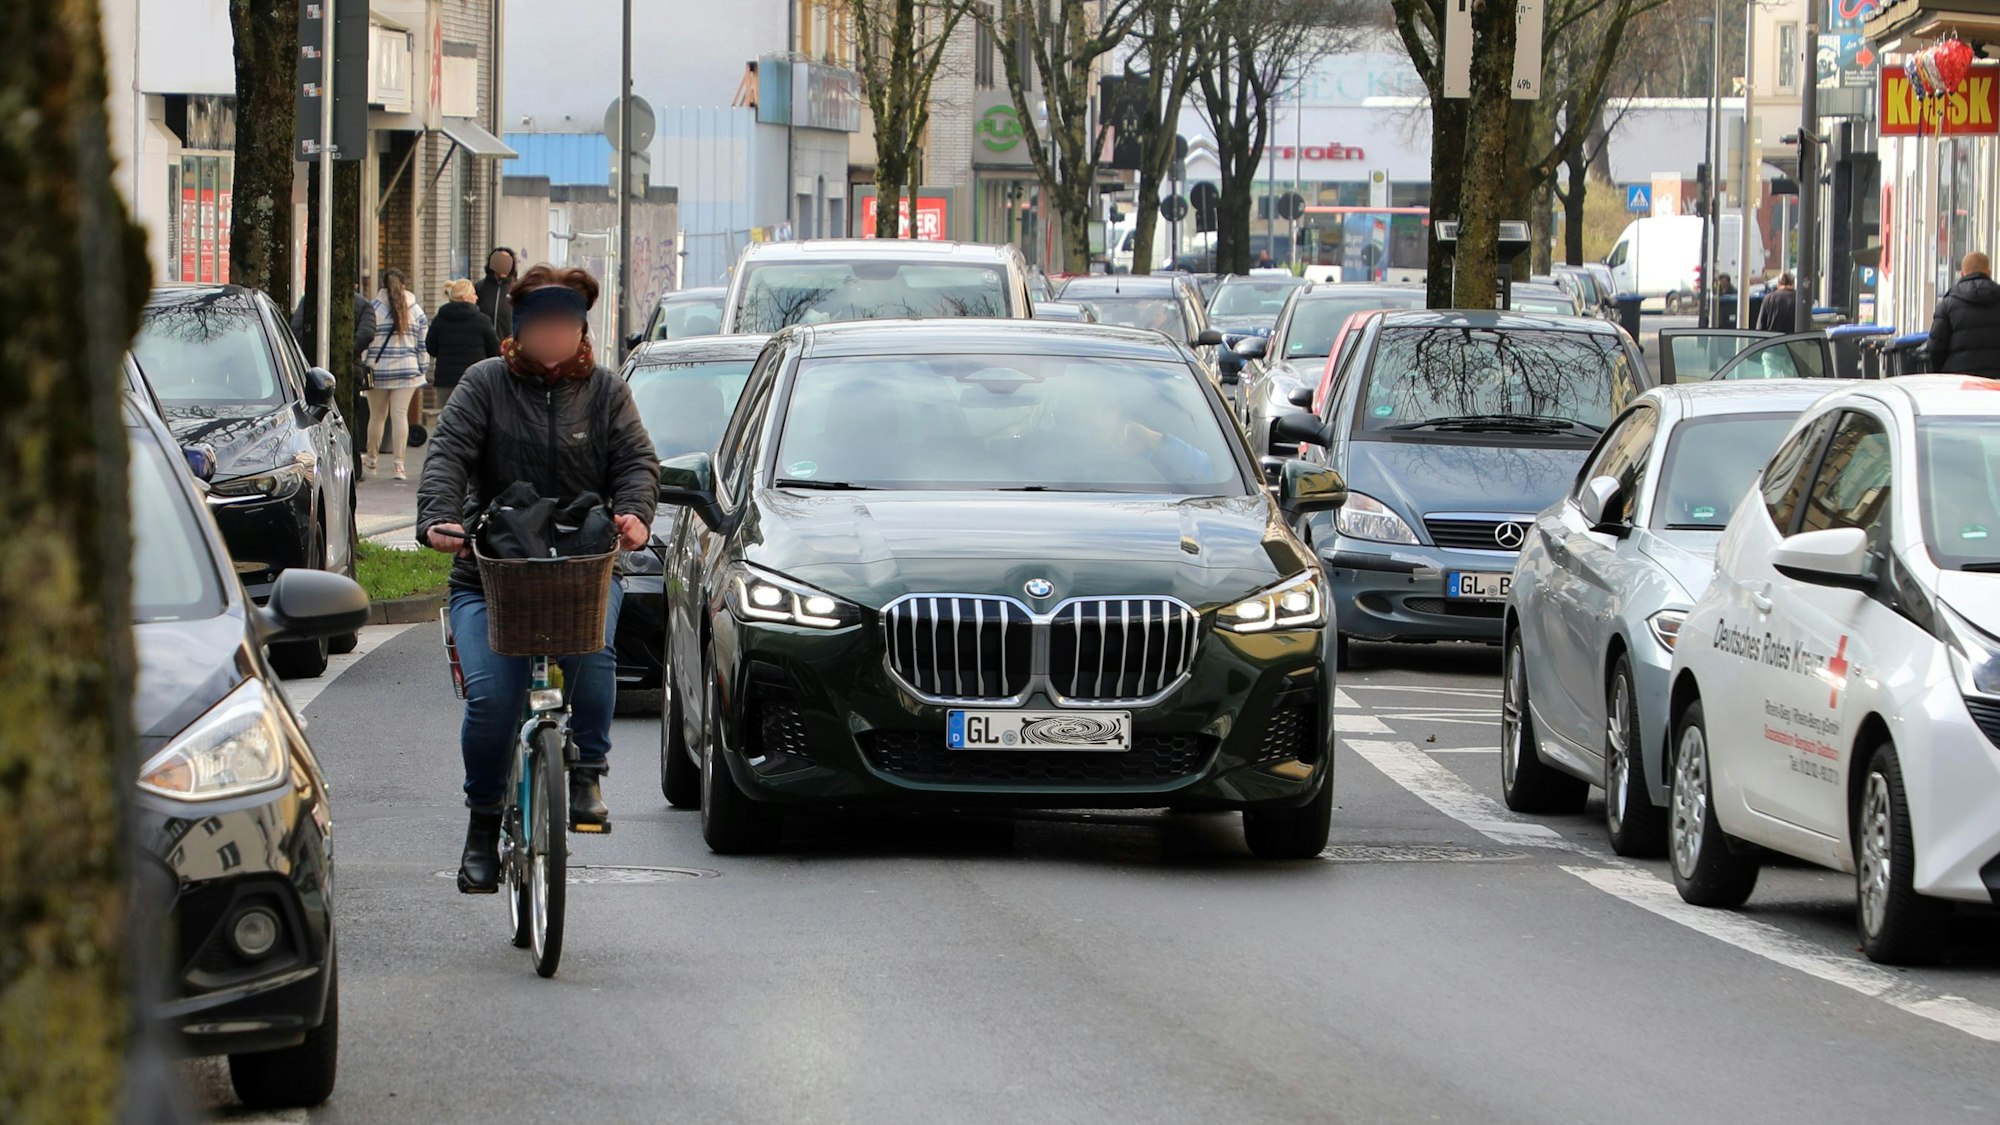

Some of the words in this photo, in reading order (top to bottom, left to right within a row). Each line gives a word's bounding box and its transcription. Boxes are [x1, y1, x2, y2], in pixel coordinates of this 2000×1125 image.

[1517, 79, 1531, 90] 49b
[1887, 77, 1993, 125] KIOSK
[1863, 267, 1874, 284] P
[1461, 576, 1485, 594] GL
[1713, 618, 1760, 661] Deutsches
[1761, 631, 1791, 670] Rotes
[967, 717, 999, 743] GL
